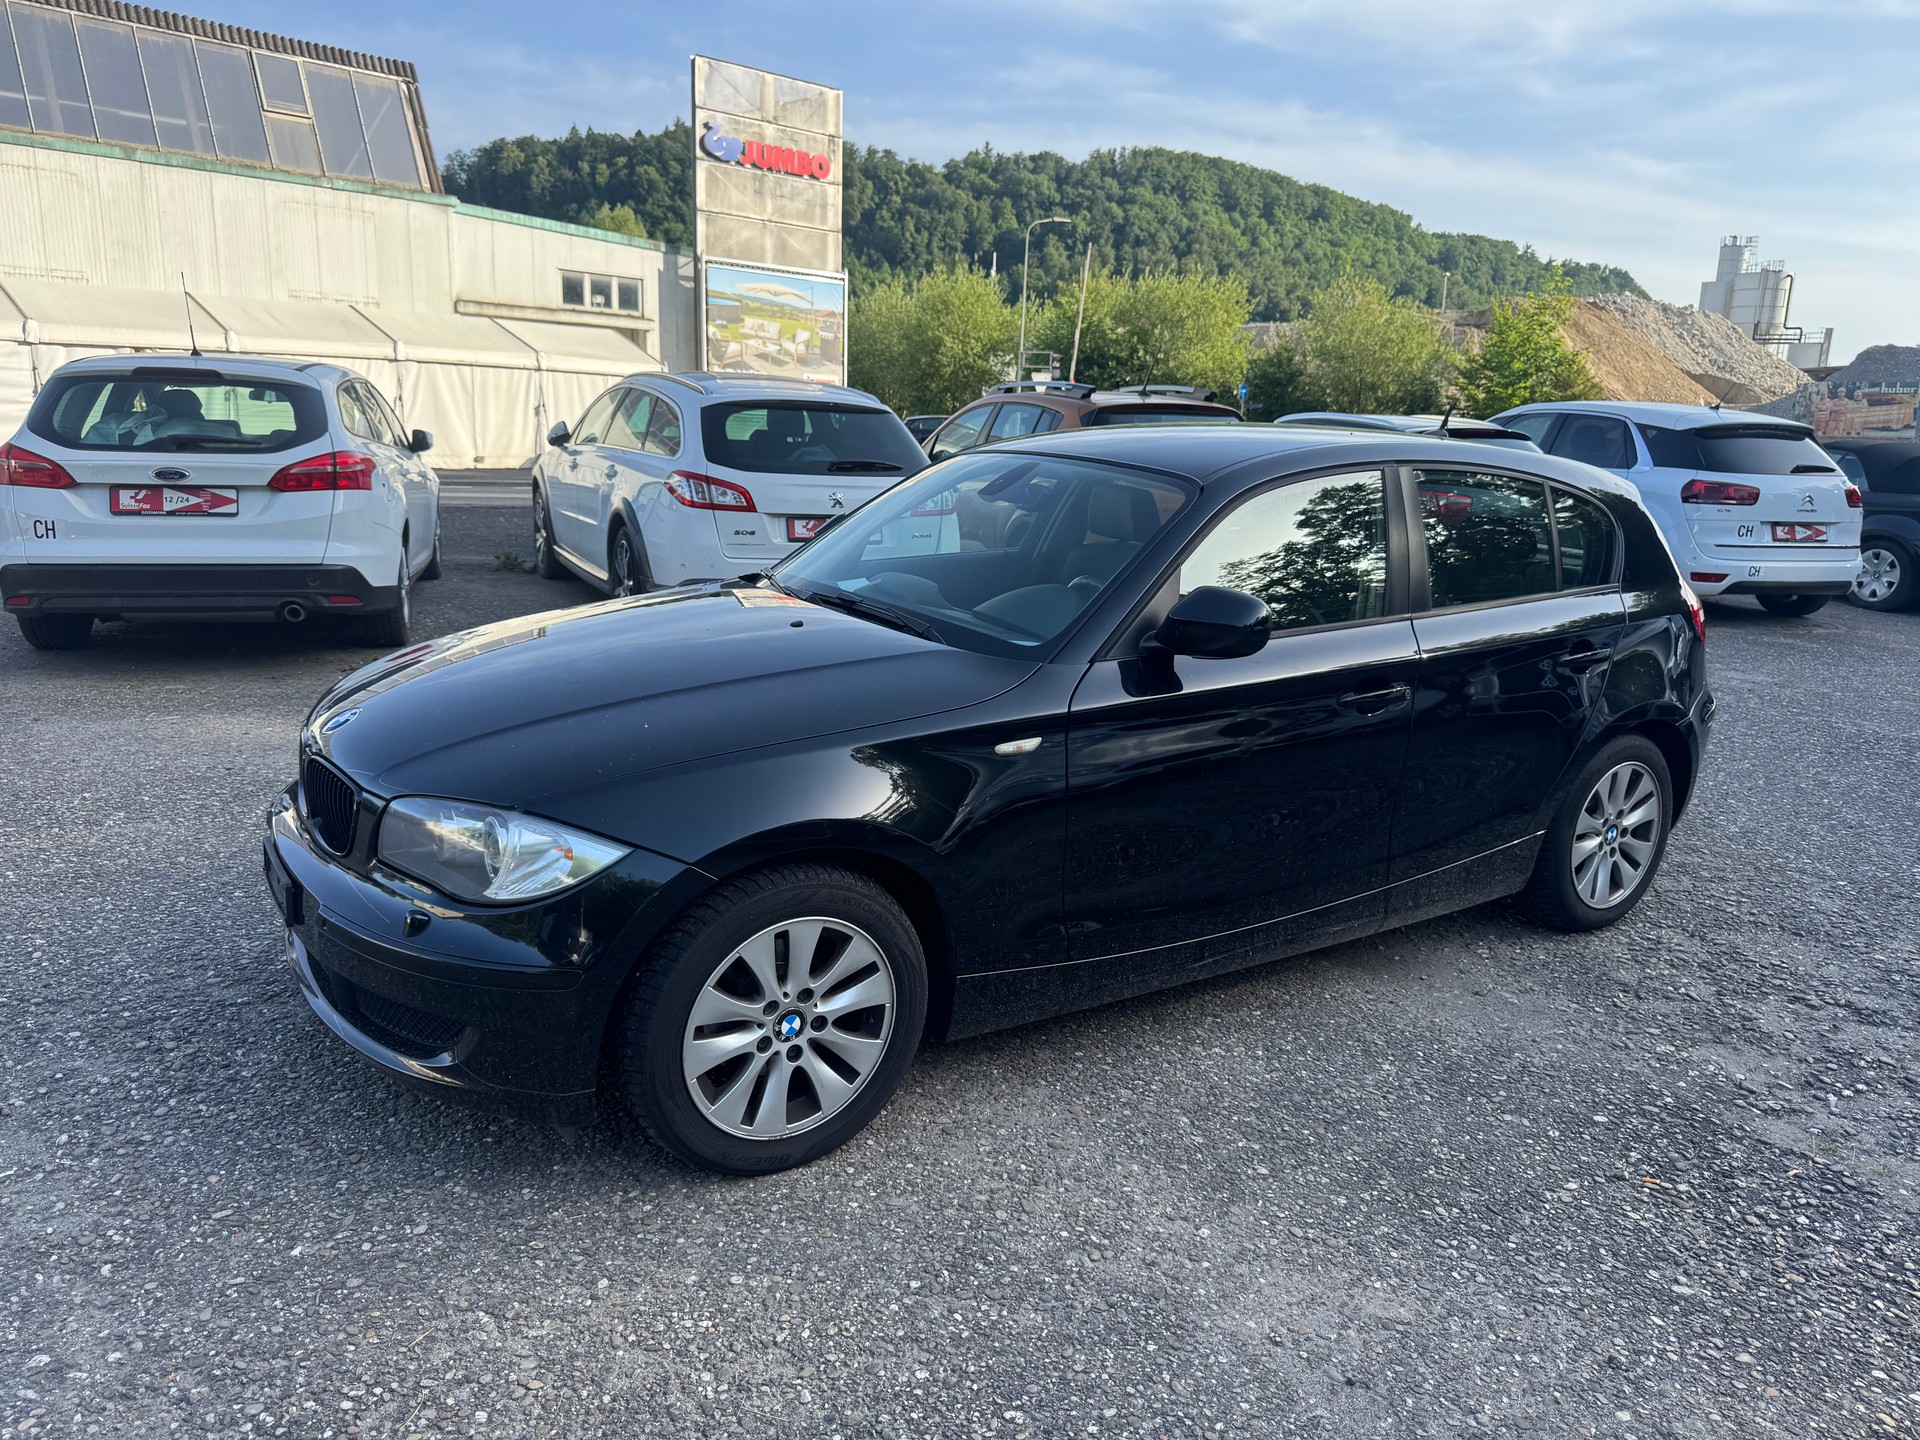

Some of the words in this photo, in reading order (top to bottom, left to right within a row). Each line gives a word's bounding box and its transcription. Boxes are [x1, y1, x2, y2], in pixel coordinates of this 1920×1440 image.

[741, 140, 831, 180] JUMBO
[1881, 382, 1918, 394] huber
[33, 519, 56, 539] CH
[1737, 525, 1754, 537] CH
[1748, 565, 1761, 577] CH
